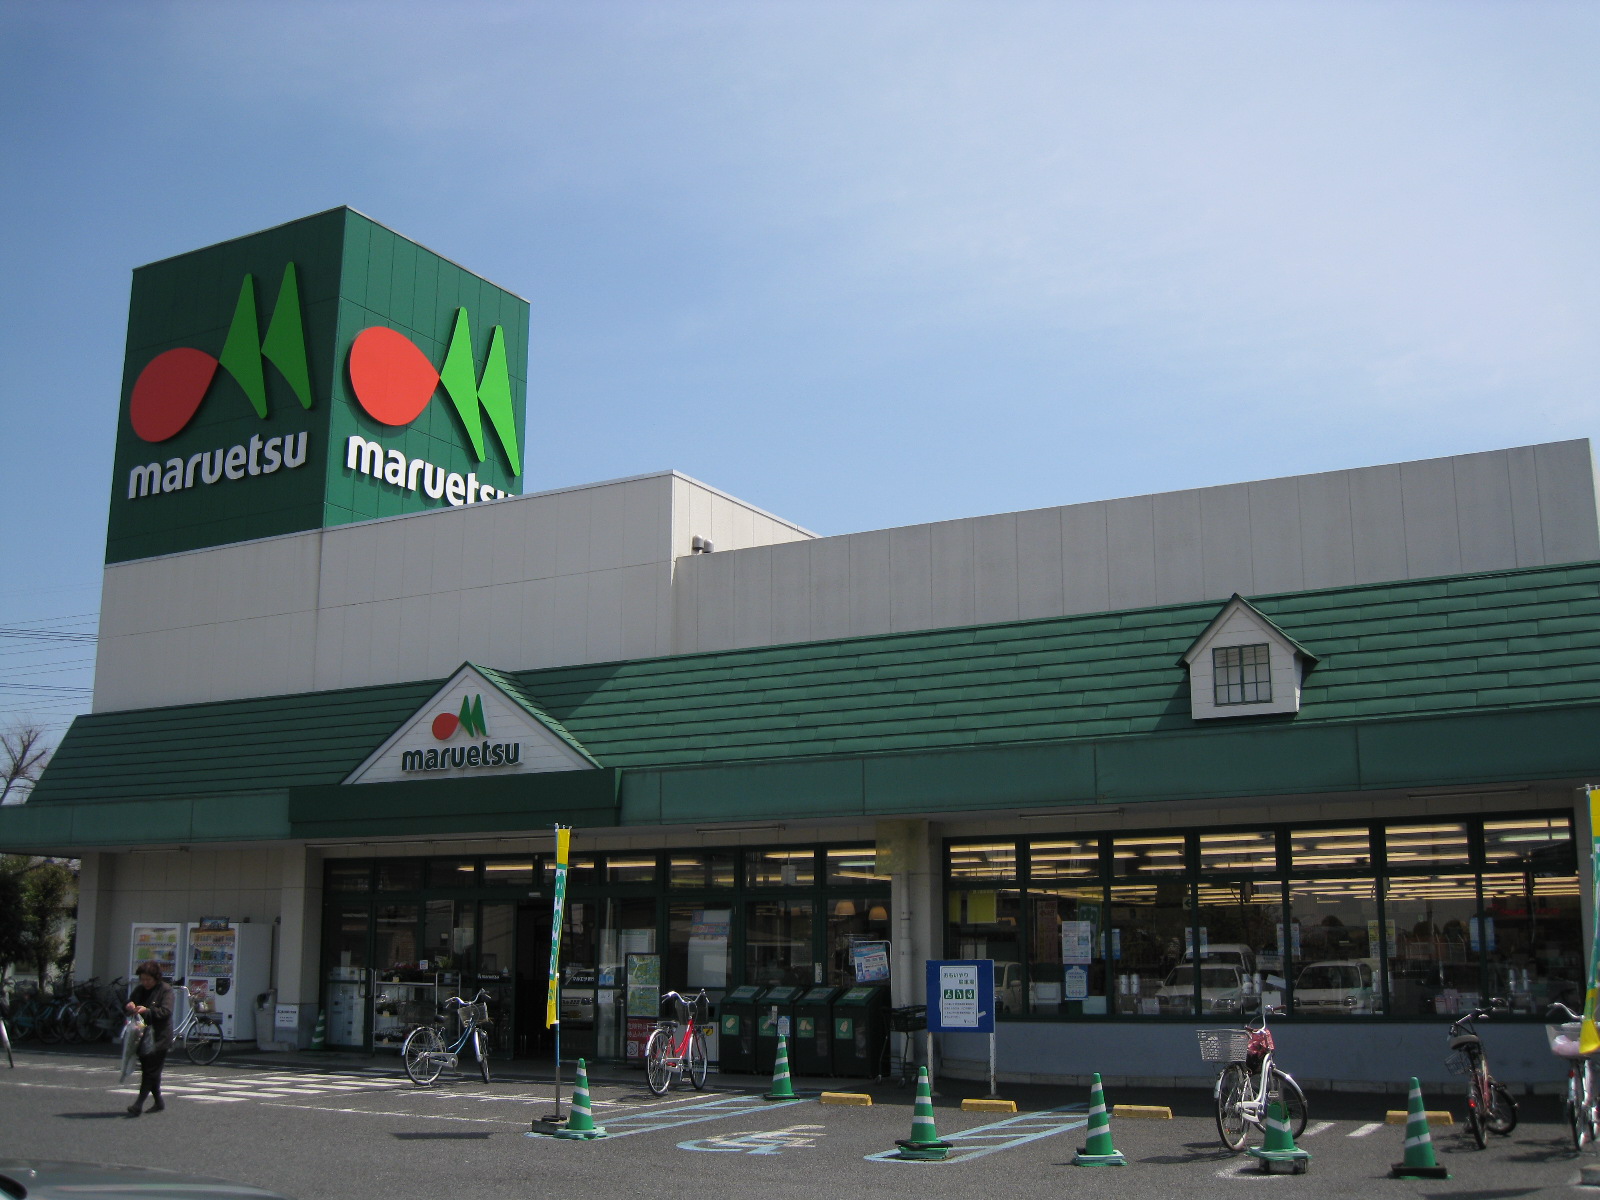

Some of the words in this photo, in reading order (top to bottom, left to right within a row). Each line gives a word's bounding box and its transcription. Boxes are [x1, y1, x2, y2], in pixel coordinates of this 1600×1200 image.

[128, 431, 308, 499] maruetsu
[346, 435, 515, 506] maruets
[402, 742, 520, 771] maruetsu
